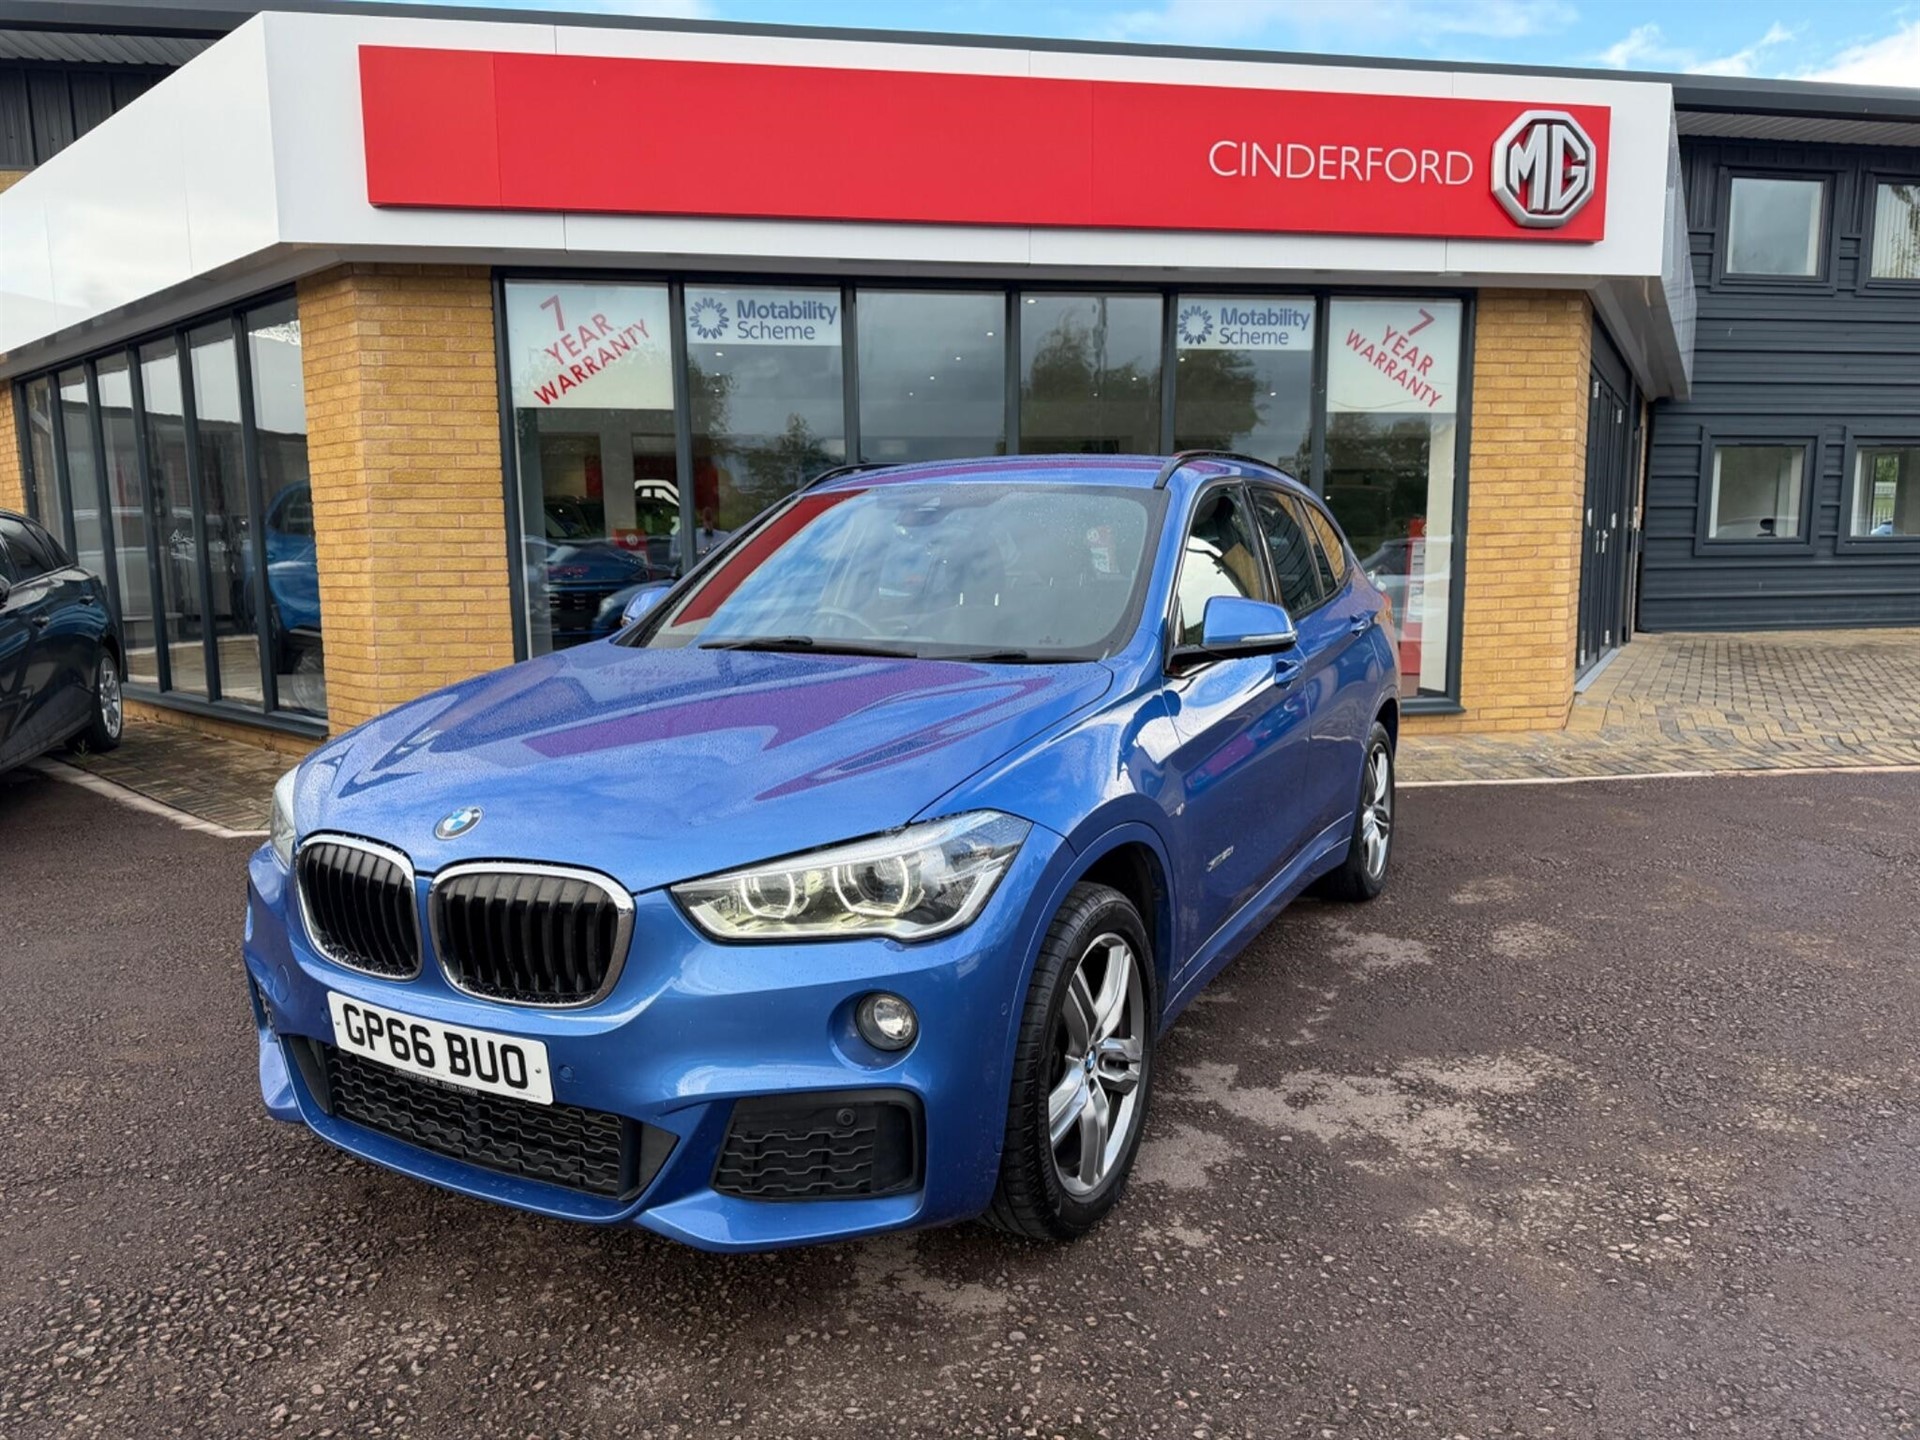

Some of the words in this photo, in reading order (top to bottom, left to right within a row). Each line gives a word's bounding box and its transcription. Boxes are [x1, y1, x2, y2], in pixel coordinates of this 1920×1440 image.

[1208, 140, 1474, 186] CINDERFORD
[1509, 123, 1587, 213] MG
[540, 294, 566, 332] 7
[737, 299, 838, 326] Motability
[737, 320, 816, 341] Scheme
[1220, 307, 1311, 331] Motability
[1408, 308, 1436, 337] 7
[544, 312, 615, 366] YEAR
[1219, 327, 1289, 346] Scheme
[1382, 325, 1434, 377] YEAR
[533, 318, 651, 406] WARRANTY
[1345, 329, 1443, 408] WARRANTY
[342, 1002, 437, 1069] GP66
[443, 1031, 529, 1090] BUO
